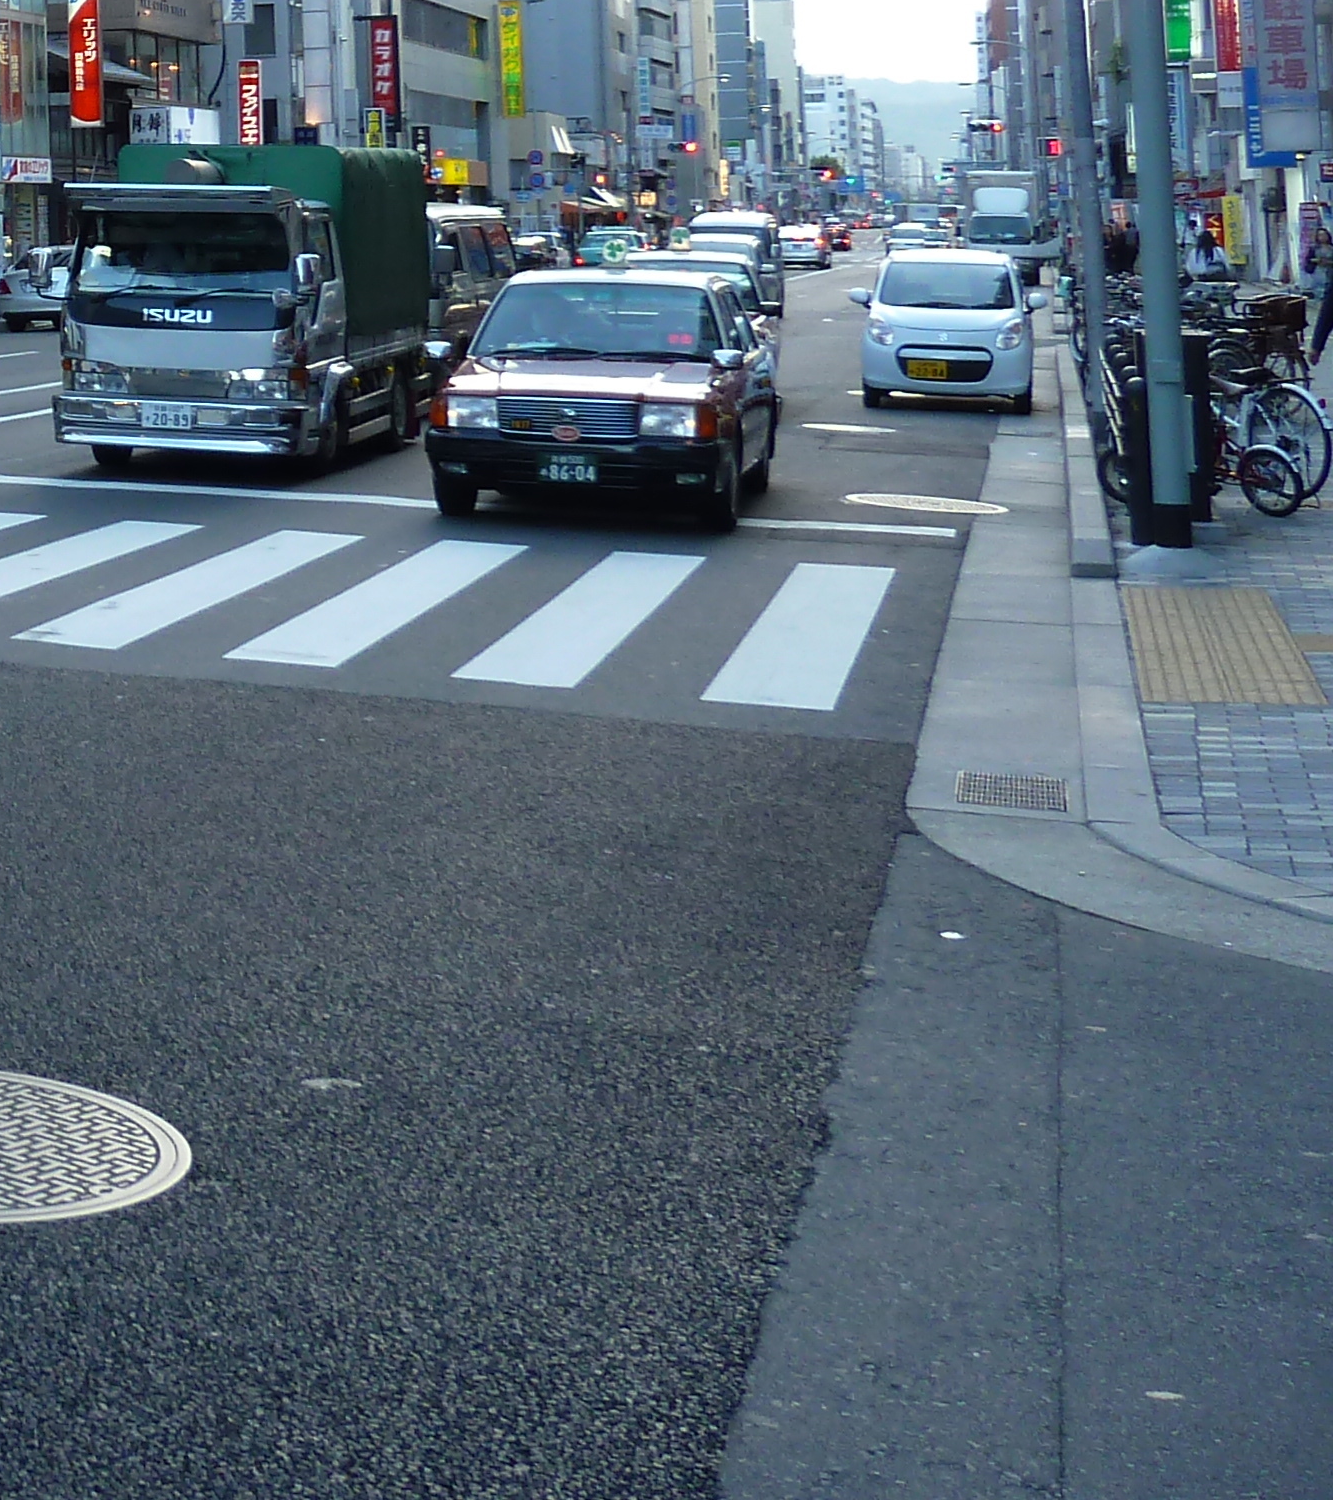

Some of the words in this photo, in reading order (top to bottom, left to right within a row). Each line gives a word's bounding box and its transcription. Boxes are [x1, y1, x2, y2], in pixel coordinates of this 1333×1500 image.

[82, 18, 97, 62] エリッツ
[375, 29, 392, 94] カラオケ
[142, 308, 212, 323] ISUZU
[152, 413, 189, 427] 20-89
[549, 465, 596, 481] 86-04
